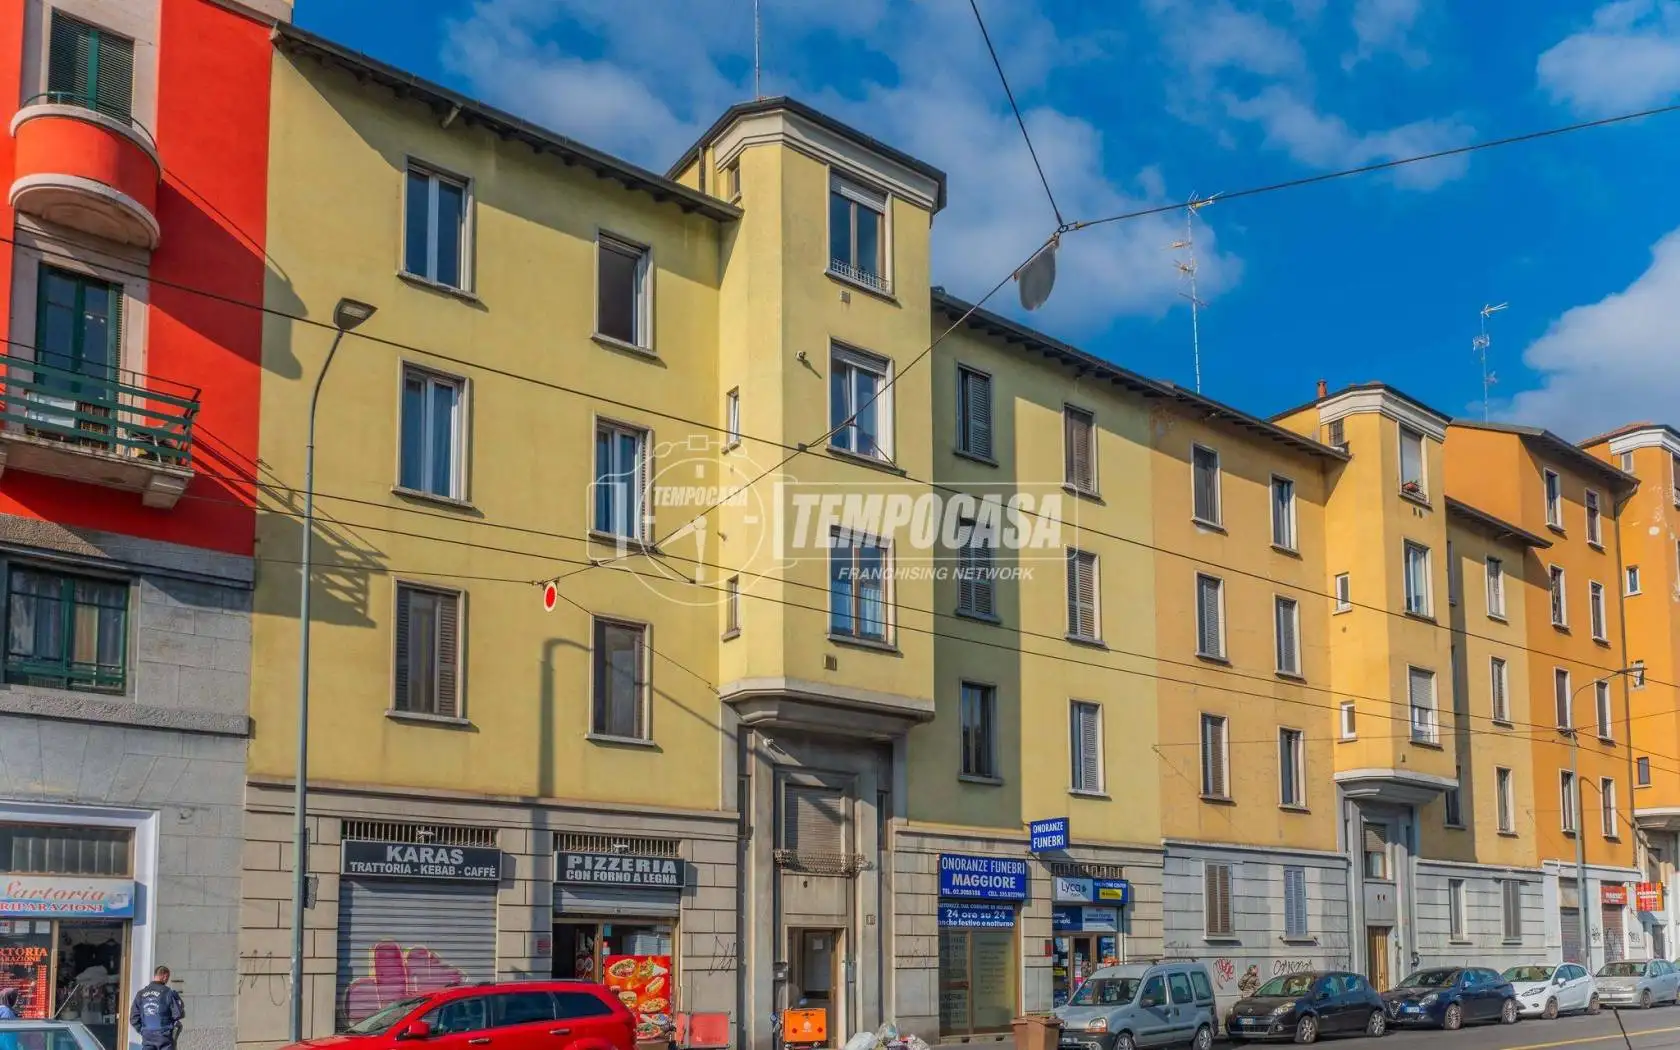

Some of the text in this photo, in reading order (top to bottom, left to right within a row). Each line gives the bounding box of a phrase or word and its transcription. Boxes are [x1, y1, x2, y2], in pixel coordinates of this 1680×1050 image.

[1032, 821, 1064, 834] ONORANZE
[1033, 835, 1064, 849] FUNEBRI
[386, 845, 464, 865] KARAS
[350, 861, 411, 874] TRATTORIA
[420, 864, 455, 876] KEBAB
[464, 865, 496, 877] CAFFÈ
[567, 855, 677, 874] PIZZERIA
[942, 857, 1025, 875] ONORANZE FUNEBRI
[566, 869, 677, 884] CON FORNO A LEGNA
[951, 873, 1016, 889] MAGGIORE
[1061, 881, 1081, 893] Lyca
[0, 902, 105, 913] RIPARAZIONI
[946, 909, 959, 918] 24
[994, 911, 1006, 920] 24
[958, 918, 981, 927] festivo
